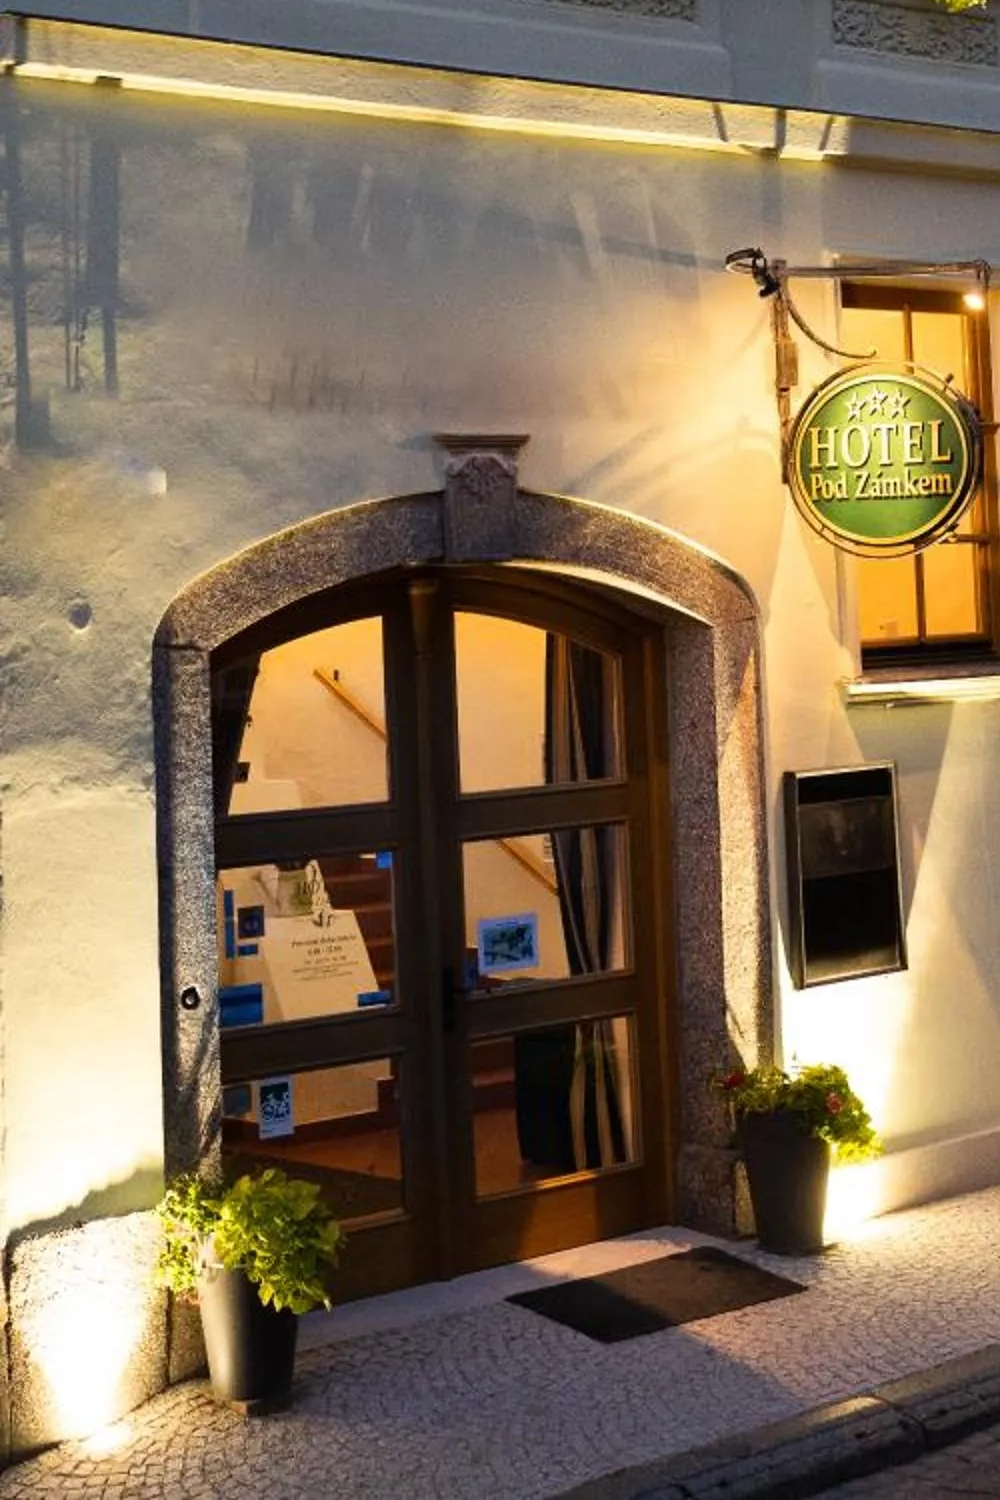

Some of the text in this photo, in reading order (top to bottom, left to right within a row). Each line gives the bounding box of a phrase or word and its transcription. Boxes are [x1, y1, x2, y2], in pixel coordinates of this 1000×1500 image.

[808, 419, 952, 469] HOTEL
[811, 469, 951, 500] Pod Zámkem
